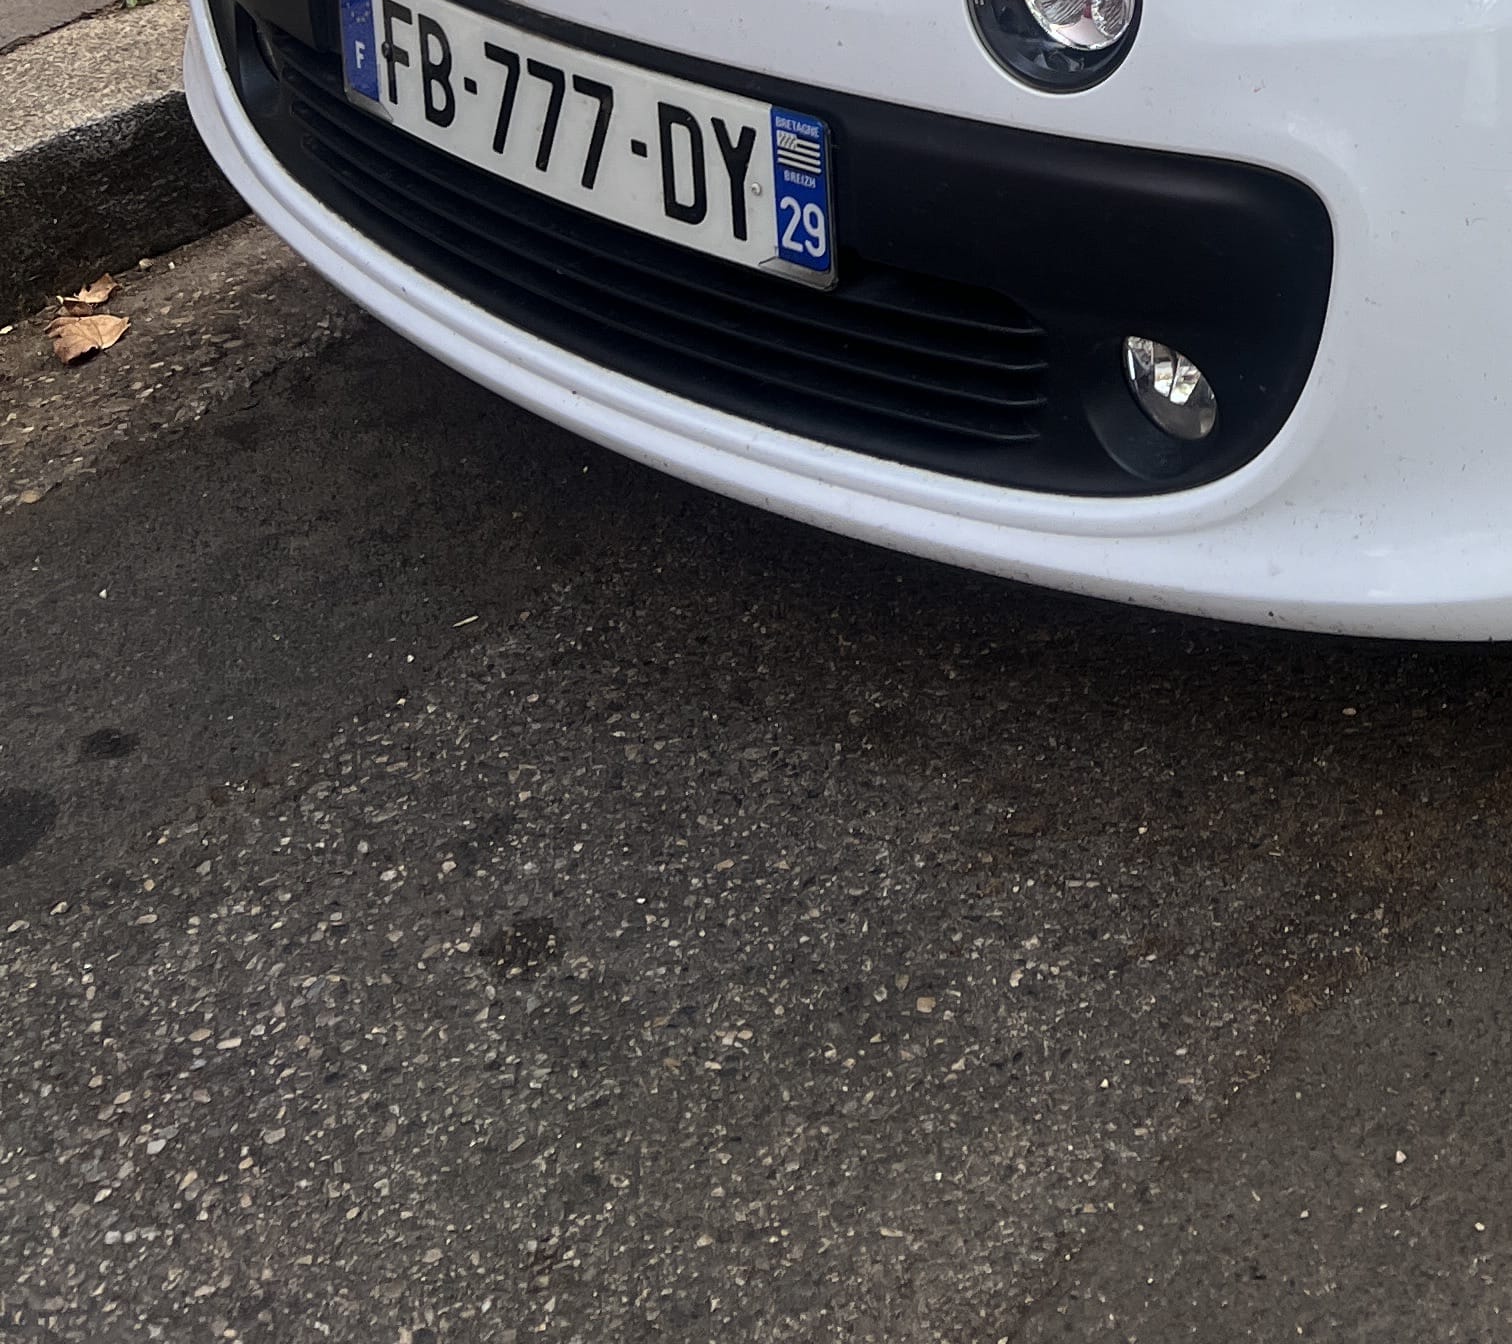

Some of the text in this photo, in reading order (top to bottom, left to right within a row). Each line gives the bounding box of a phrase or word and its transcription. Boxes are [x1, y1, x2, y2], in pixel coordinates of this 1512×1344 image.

[354, 40, 366, 70] F
[775, 116, 820, 138] BRETAGNE
[783, 169, 816, 189] BREIZH
[780, 196, 826, 258] 29
